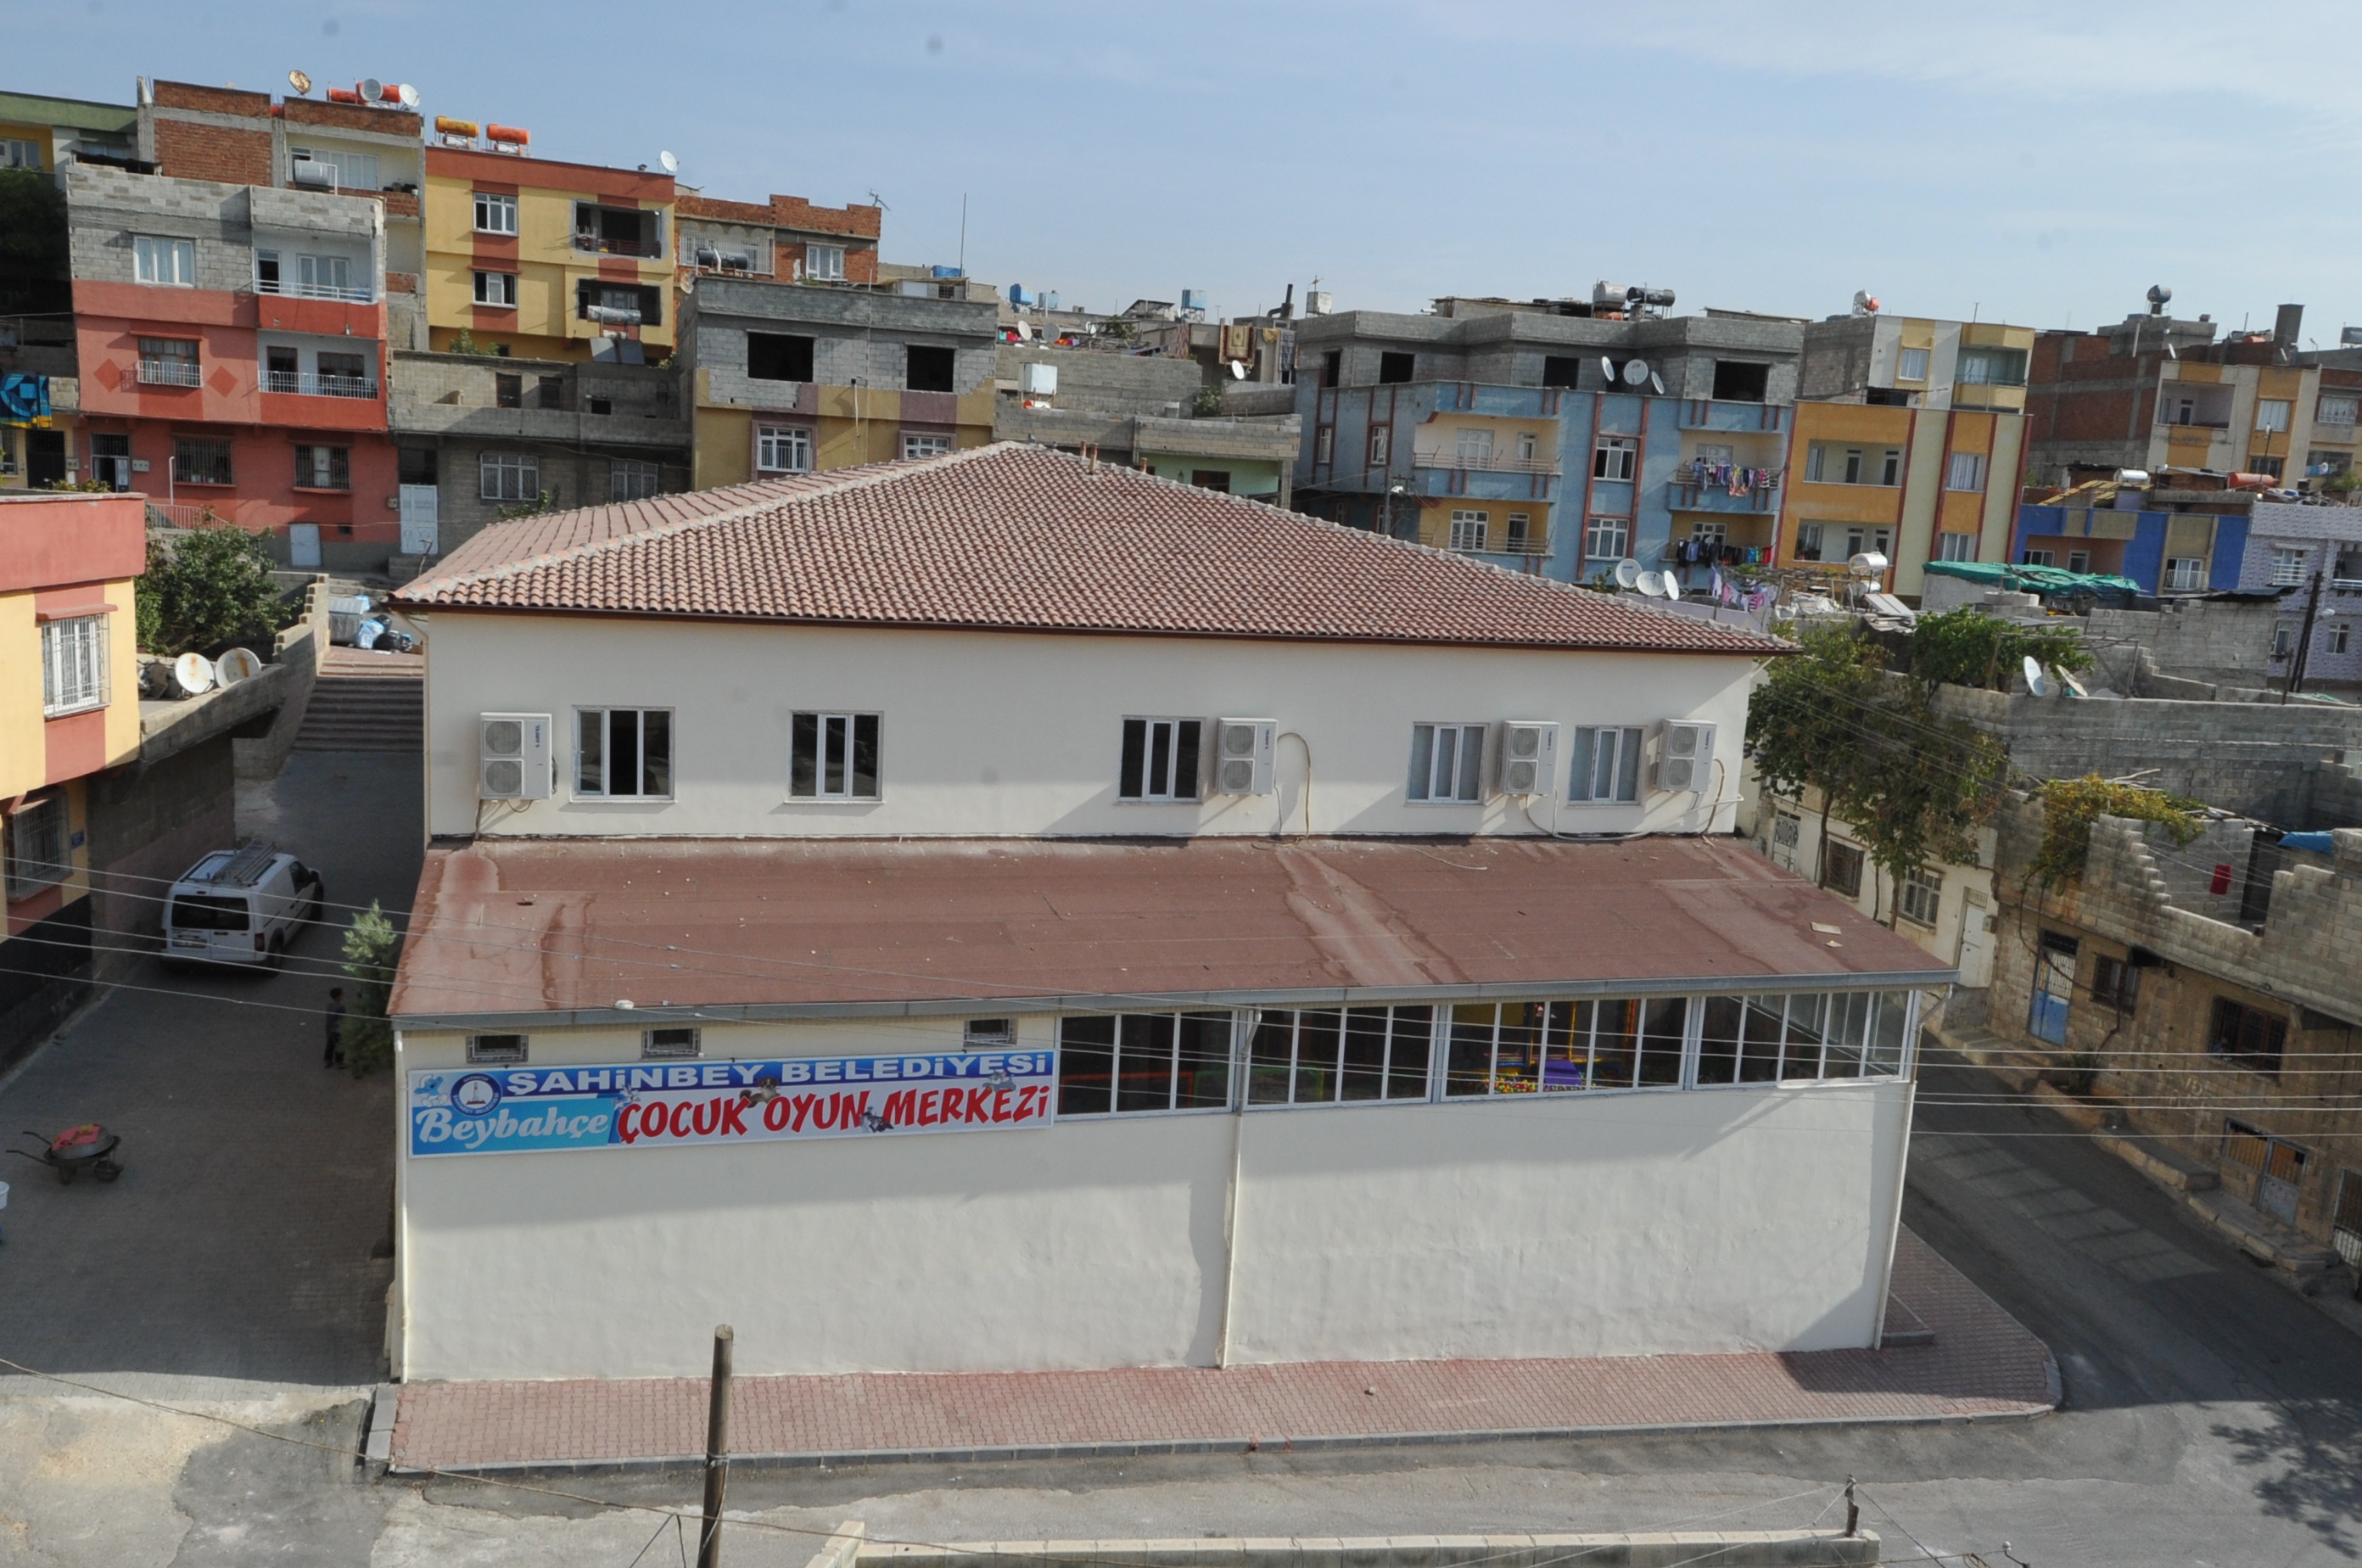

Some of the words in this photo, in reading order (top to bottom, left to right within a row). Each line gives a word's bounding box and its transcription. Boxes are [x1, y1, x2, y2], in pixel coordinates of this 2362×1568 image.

[415, 1106, 609, 1150] Beybahçe
[617, 1095, 752, 1145] ÇOCUK
[763, 1089, 871, 1133] OYUN
